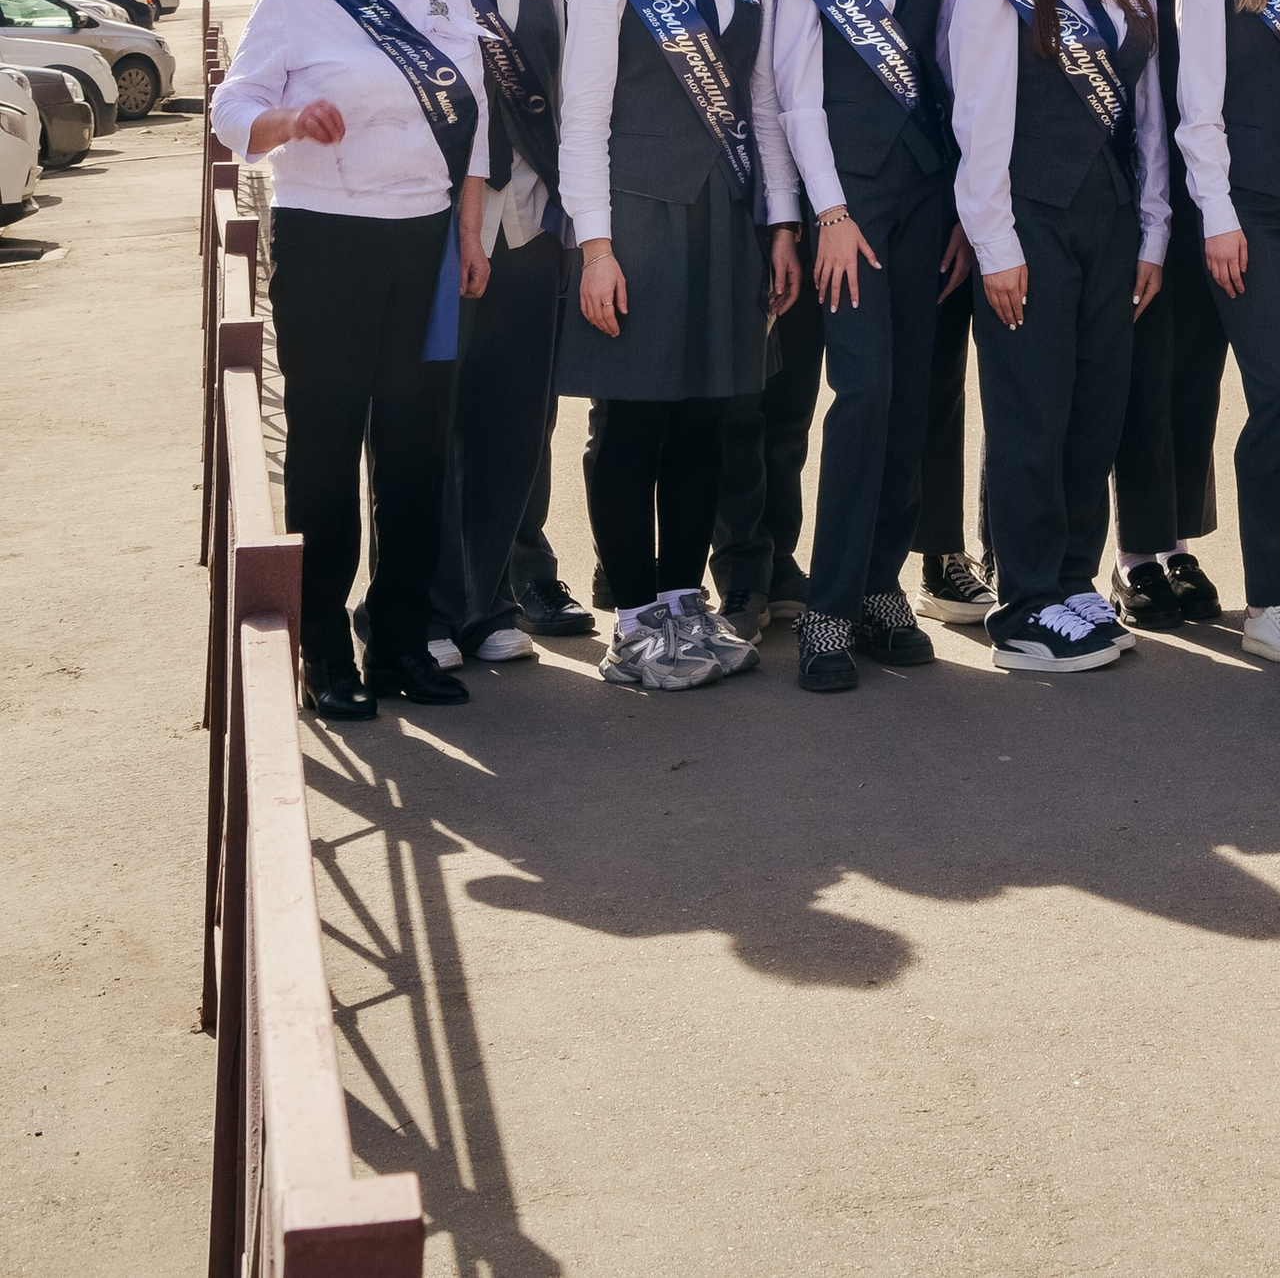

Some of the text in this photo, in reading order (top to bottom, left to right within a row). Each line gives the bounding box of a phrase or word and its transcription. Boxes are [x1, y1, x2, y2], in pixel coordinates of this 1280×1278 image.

[642, 8, 668, 42] 2025 год
[827, 5, 856, 37] 2025 год
[424, 66, 457, 87] 9
[683, 73, 701, 93] ГАОУ
[696, 95, 708, 107] СО
[877, 63, 905, 94] ГАОУ СО
[1087, 94, 1111, 125] ГАОУ СО
